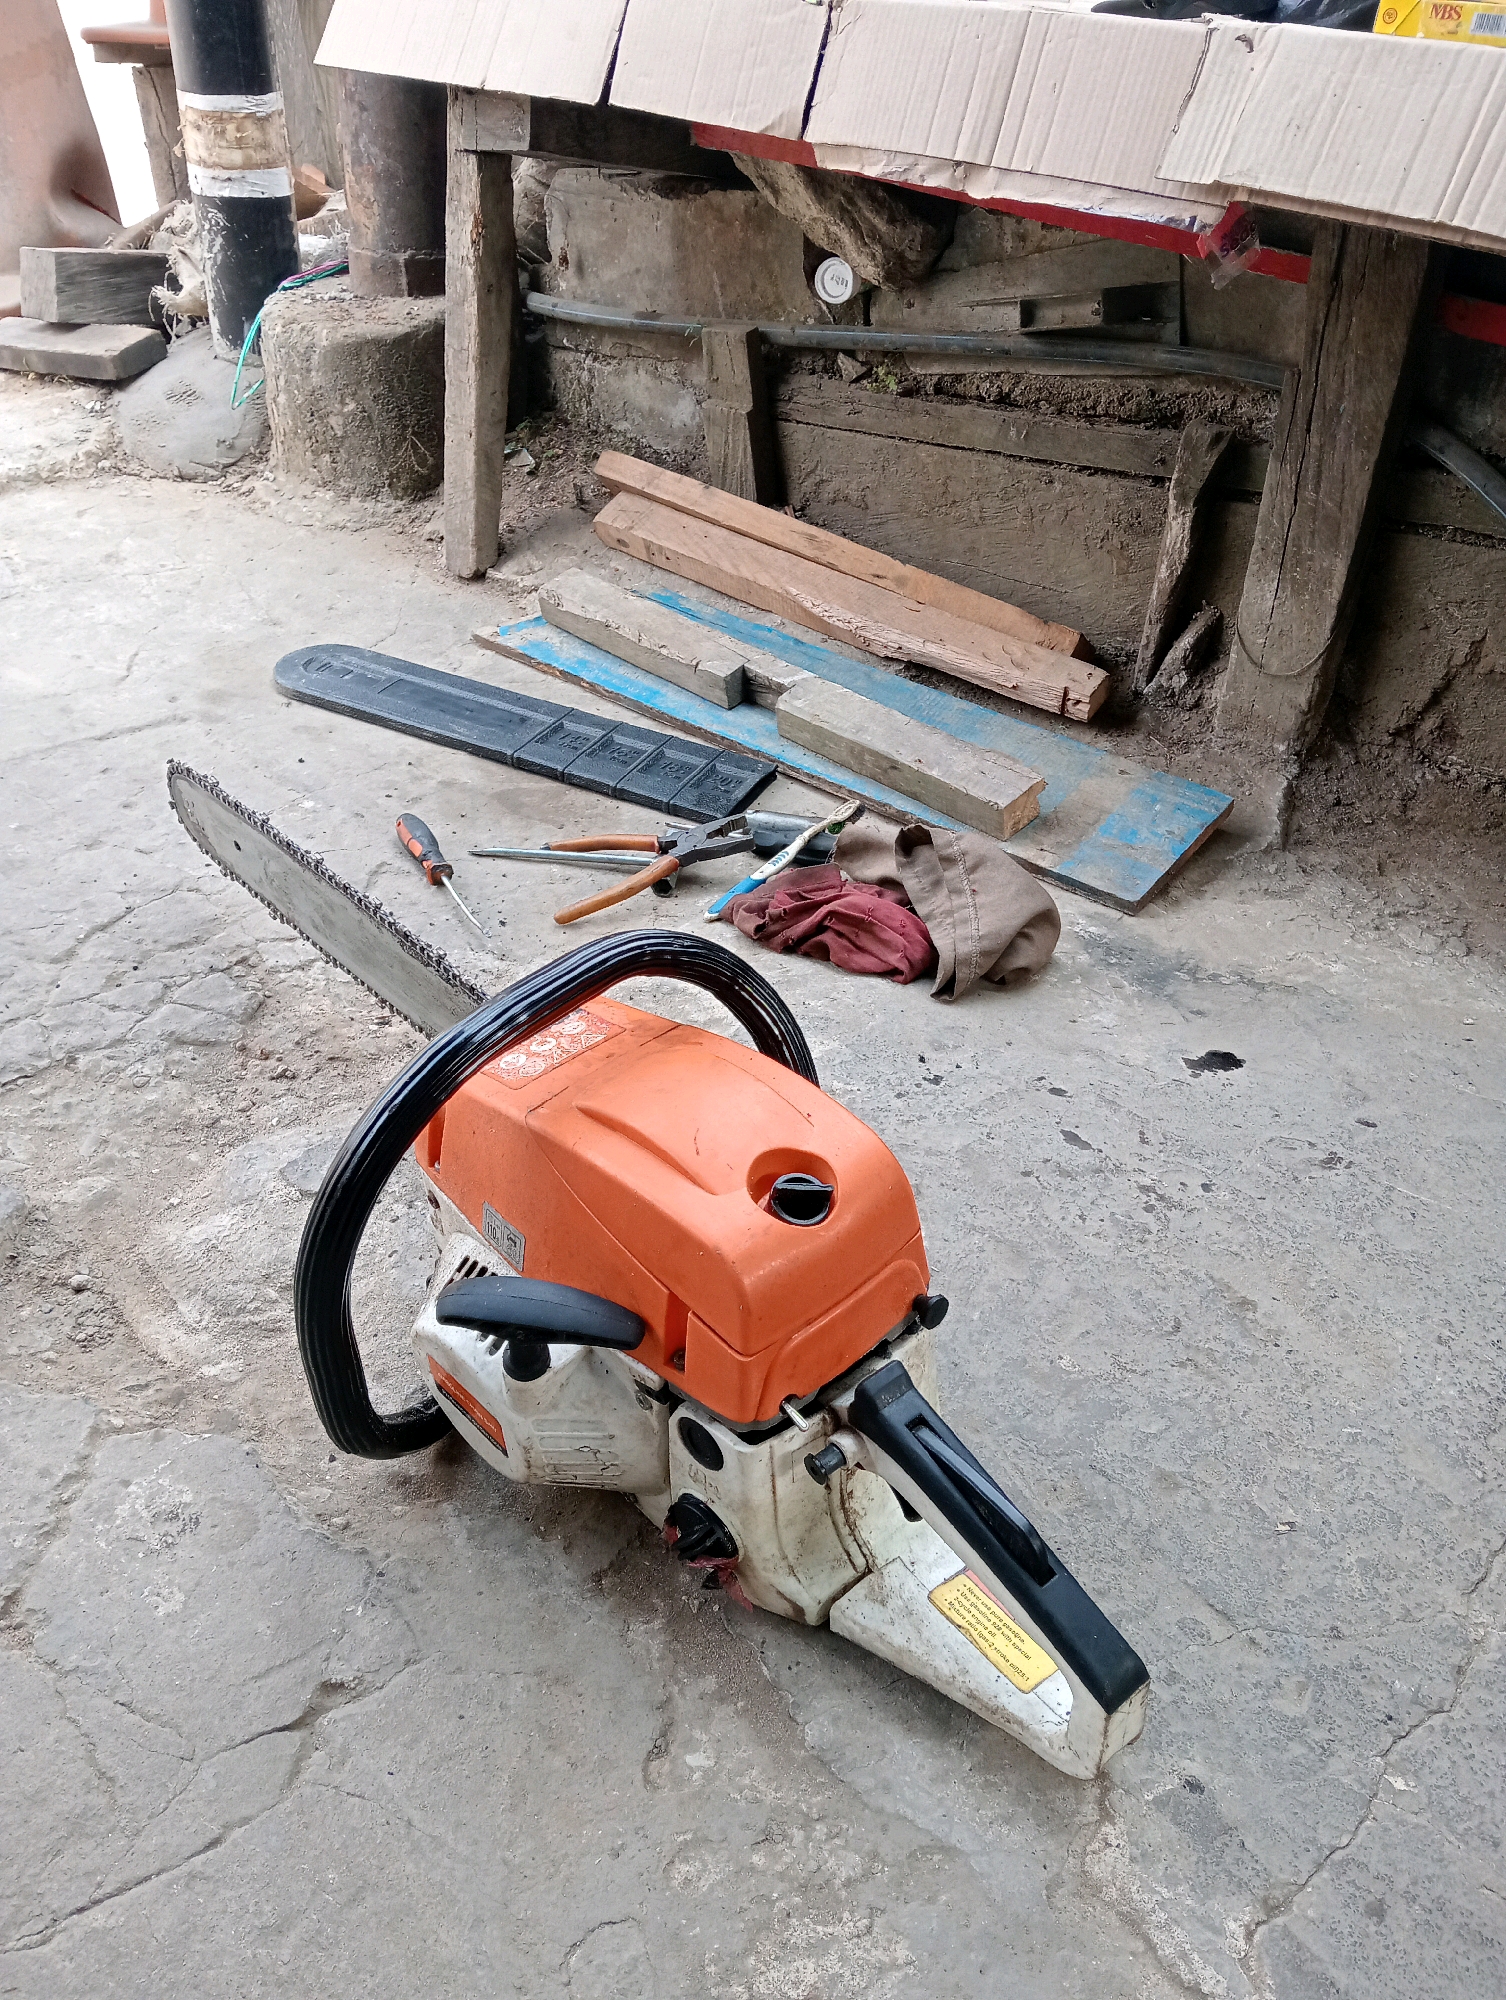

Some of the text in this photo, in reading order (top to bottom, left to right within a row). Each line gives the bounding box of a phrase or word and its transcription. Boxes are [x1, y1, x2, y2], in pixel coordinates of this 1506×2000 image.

[487, 1221, 496, 1239] 110
[948, 1601, 966, 1620] Mixture
[965, 1619, 979, 1632] ratio
[993, 1645, 1010, 1663] stroke
[954, 1597, 997, 1639] 2-cycle engine oil.
[960, 1591, 969, 1600] Use
[969, 1601, 991, 1623] gasoline
[1001, 1631, 1012, 1643] with
[1012, 1642, 1032, 1661] special
[967, 1586, 1025, 1645] Never use pure gasoline.
